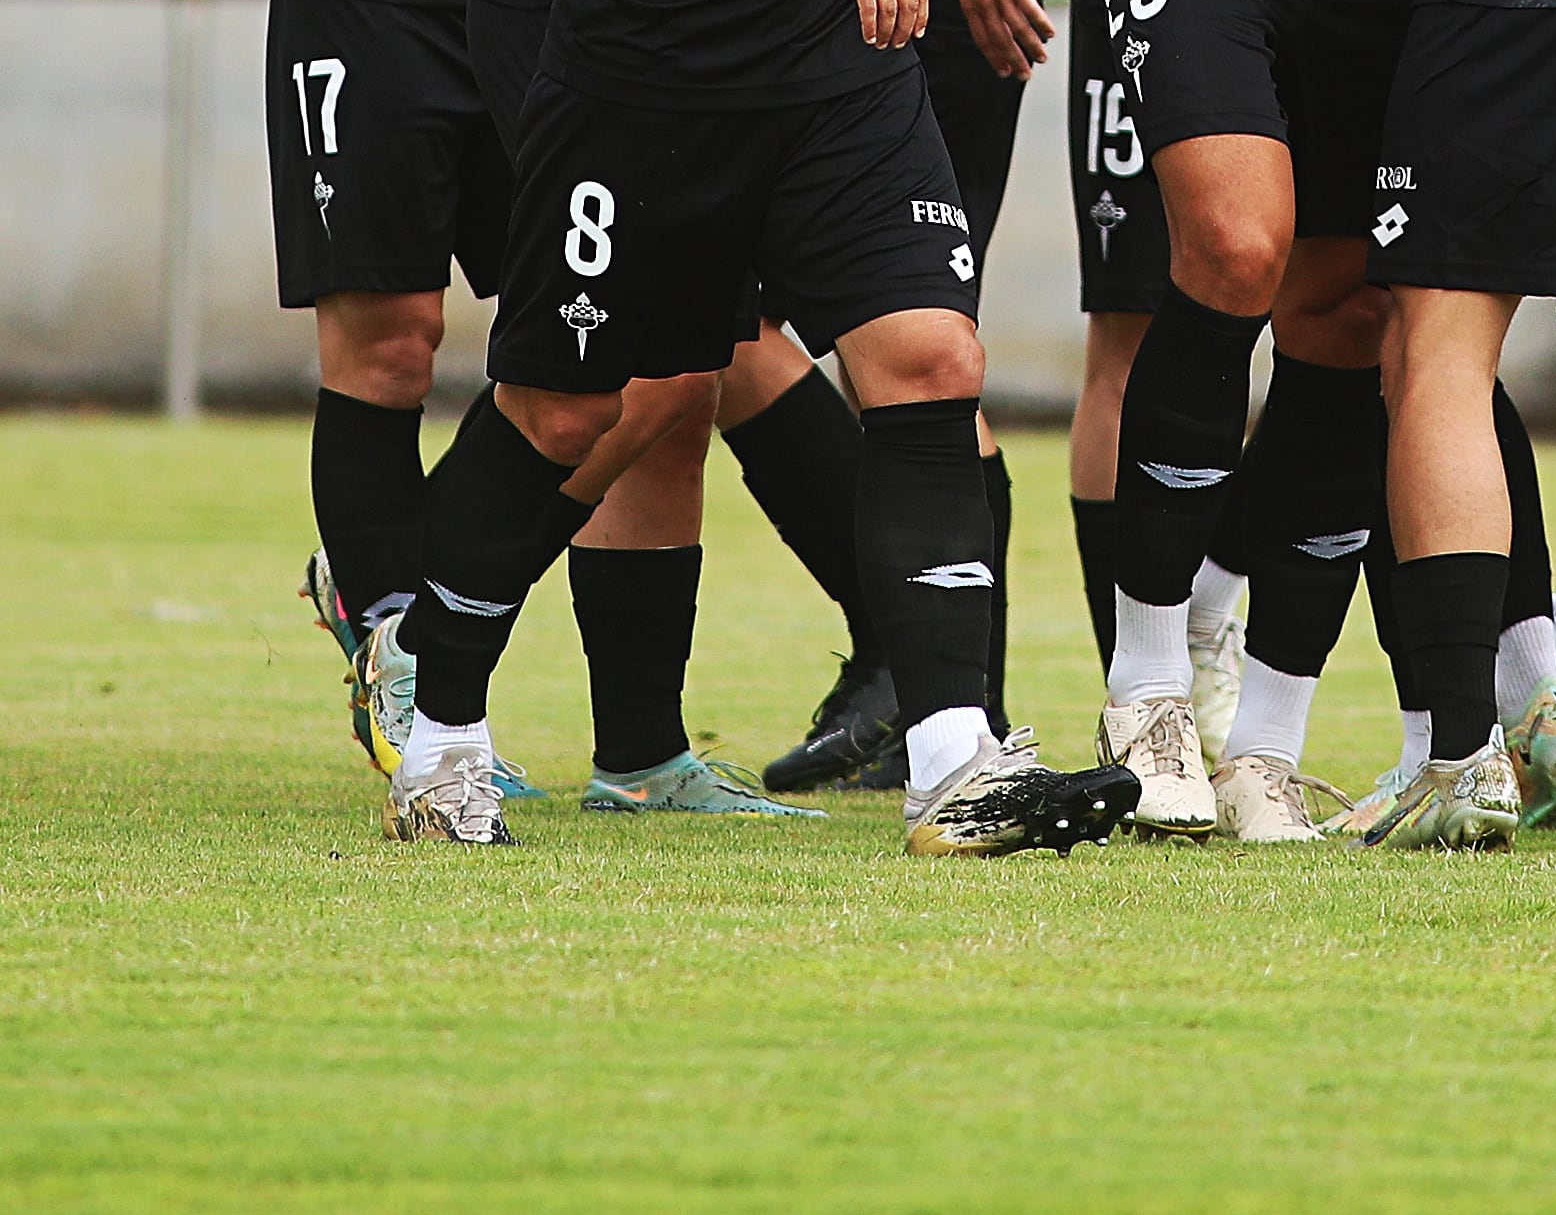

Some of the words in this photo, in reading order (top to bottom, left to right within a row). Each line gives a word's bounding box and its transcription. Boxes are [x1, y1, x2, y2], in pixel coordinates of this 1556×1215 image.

[291, 57, 347, 157] 17
[1084, 78, 1145, 177] 15
[563, 181, 616, 277] 8
